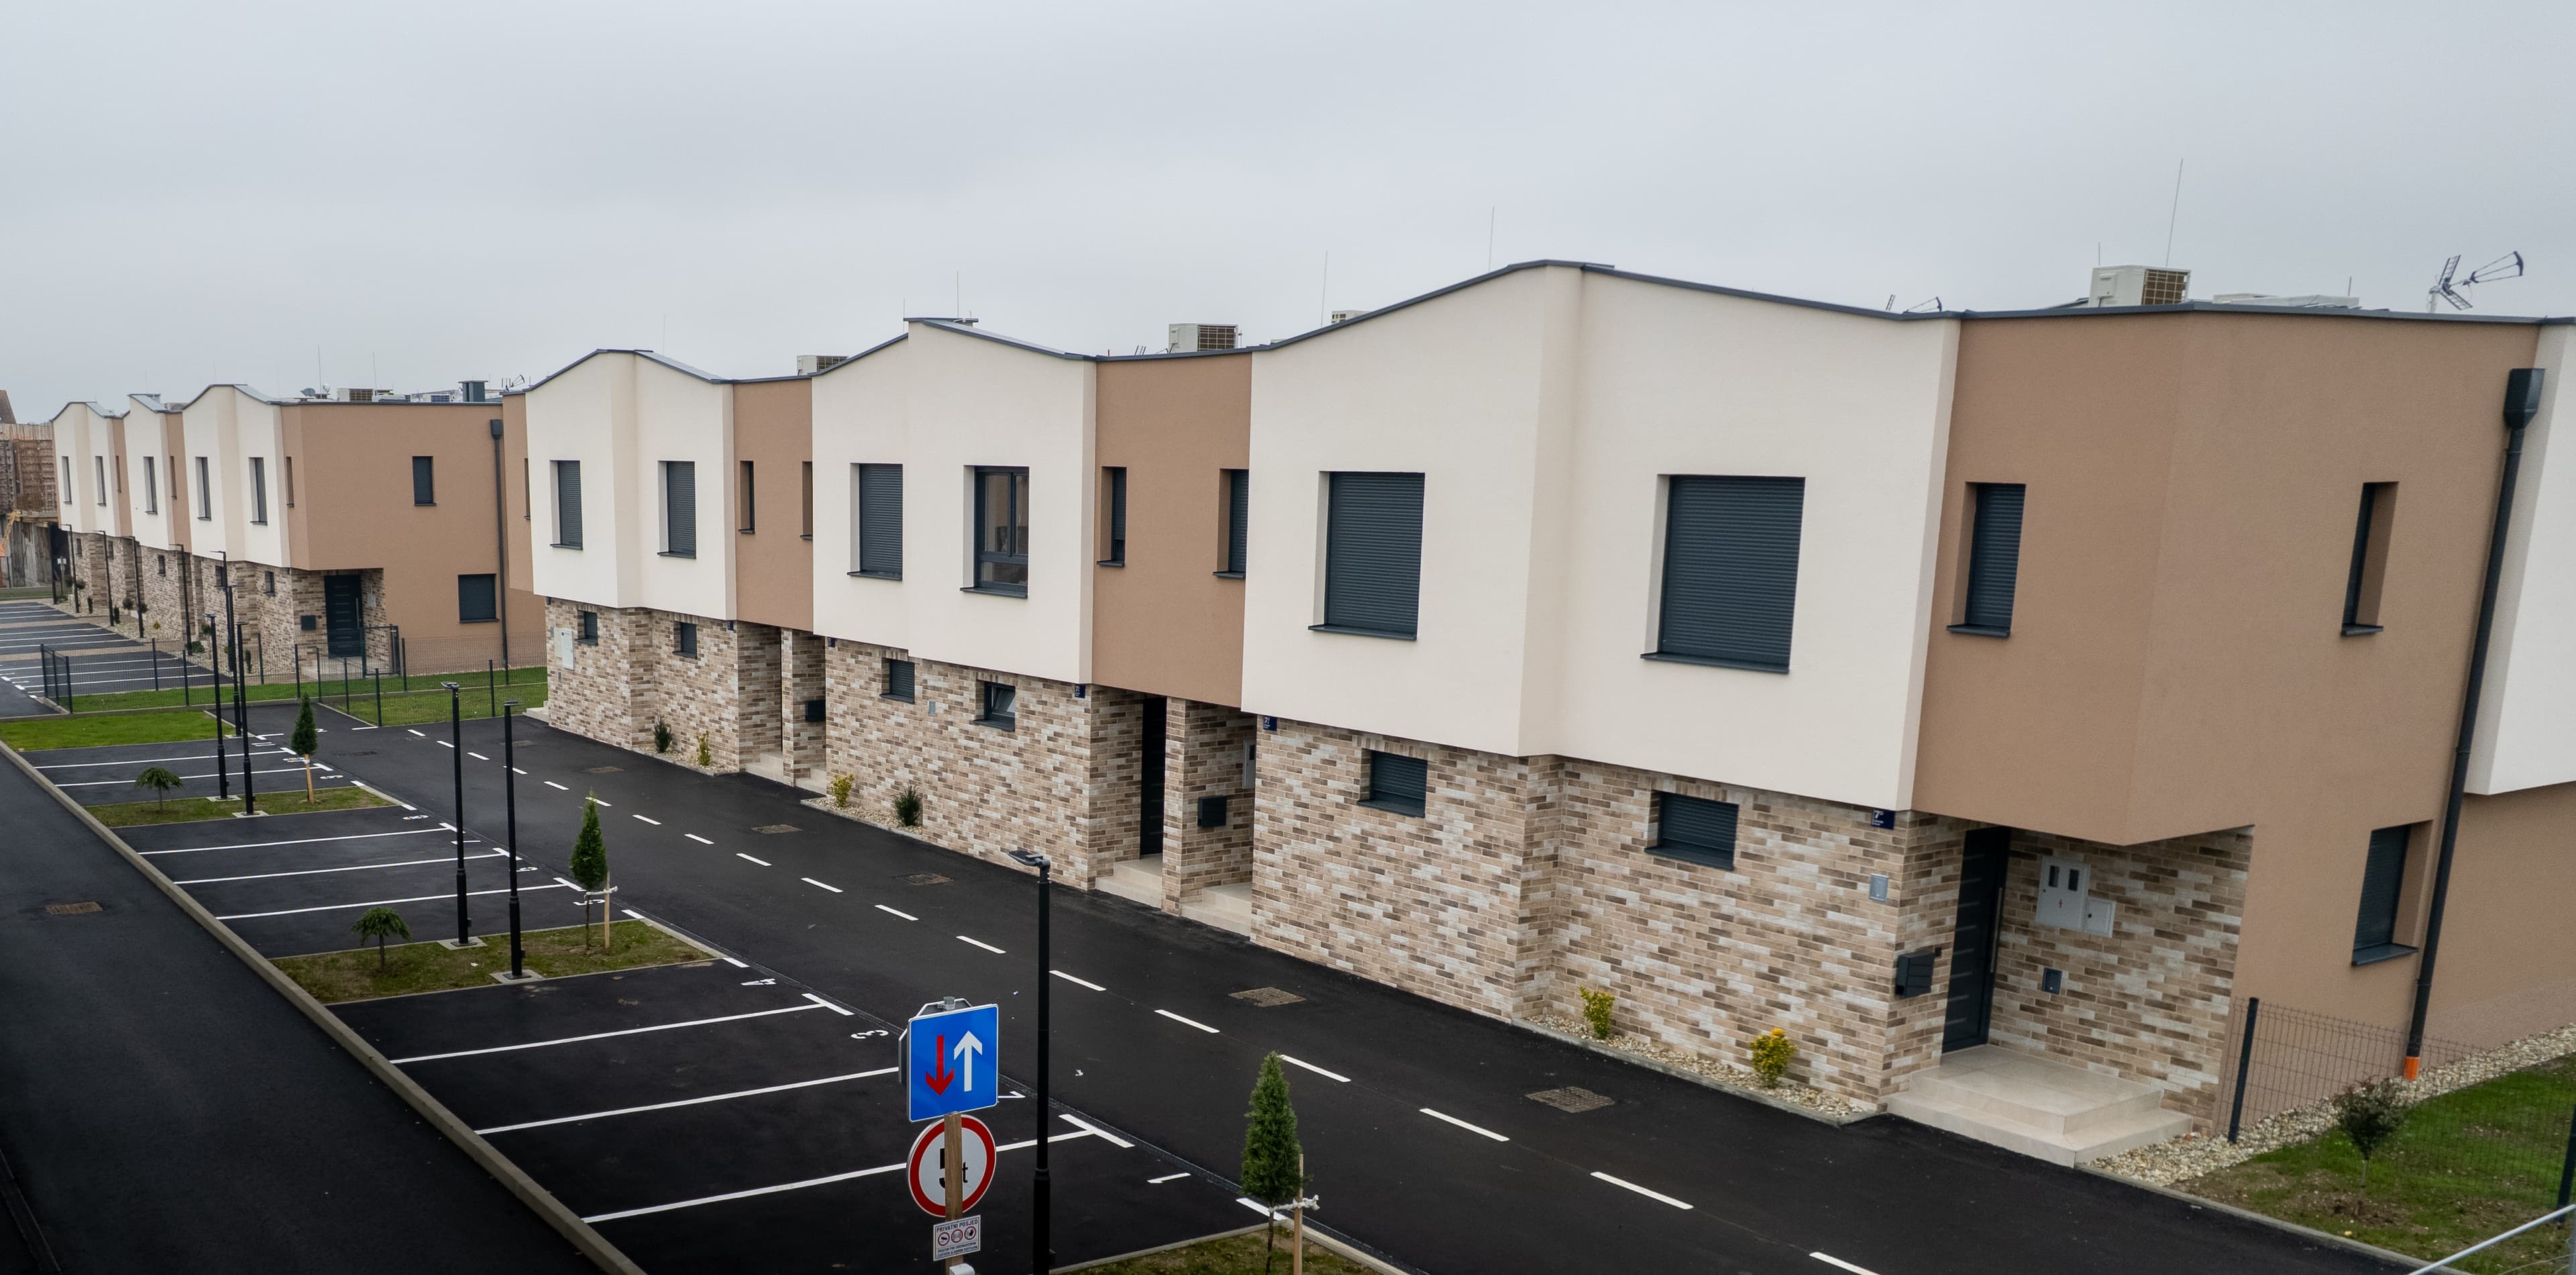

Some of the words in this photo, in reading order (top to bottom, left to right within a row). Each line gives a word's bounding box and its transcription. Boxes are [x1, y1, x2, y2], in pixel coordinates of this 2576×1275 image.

[851, 1029, 889, 1039] 3
[936, 1224, 958, 1232] PRIVATNI
[959, 1219, 977, 1227] POSJED
